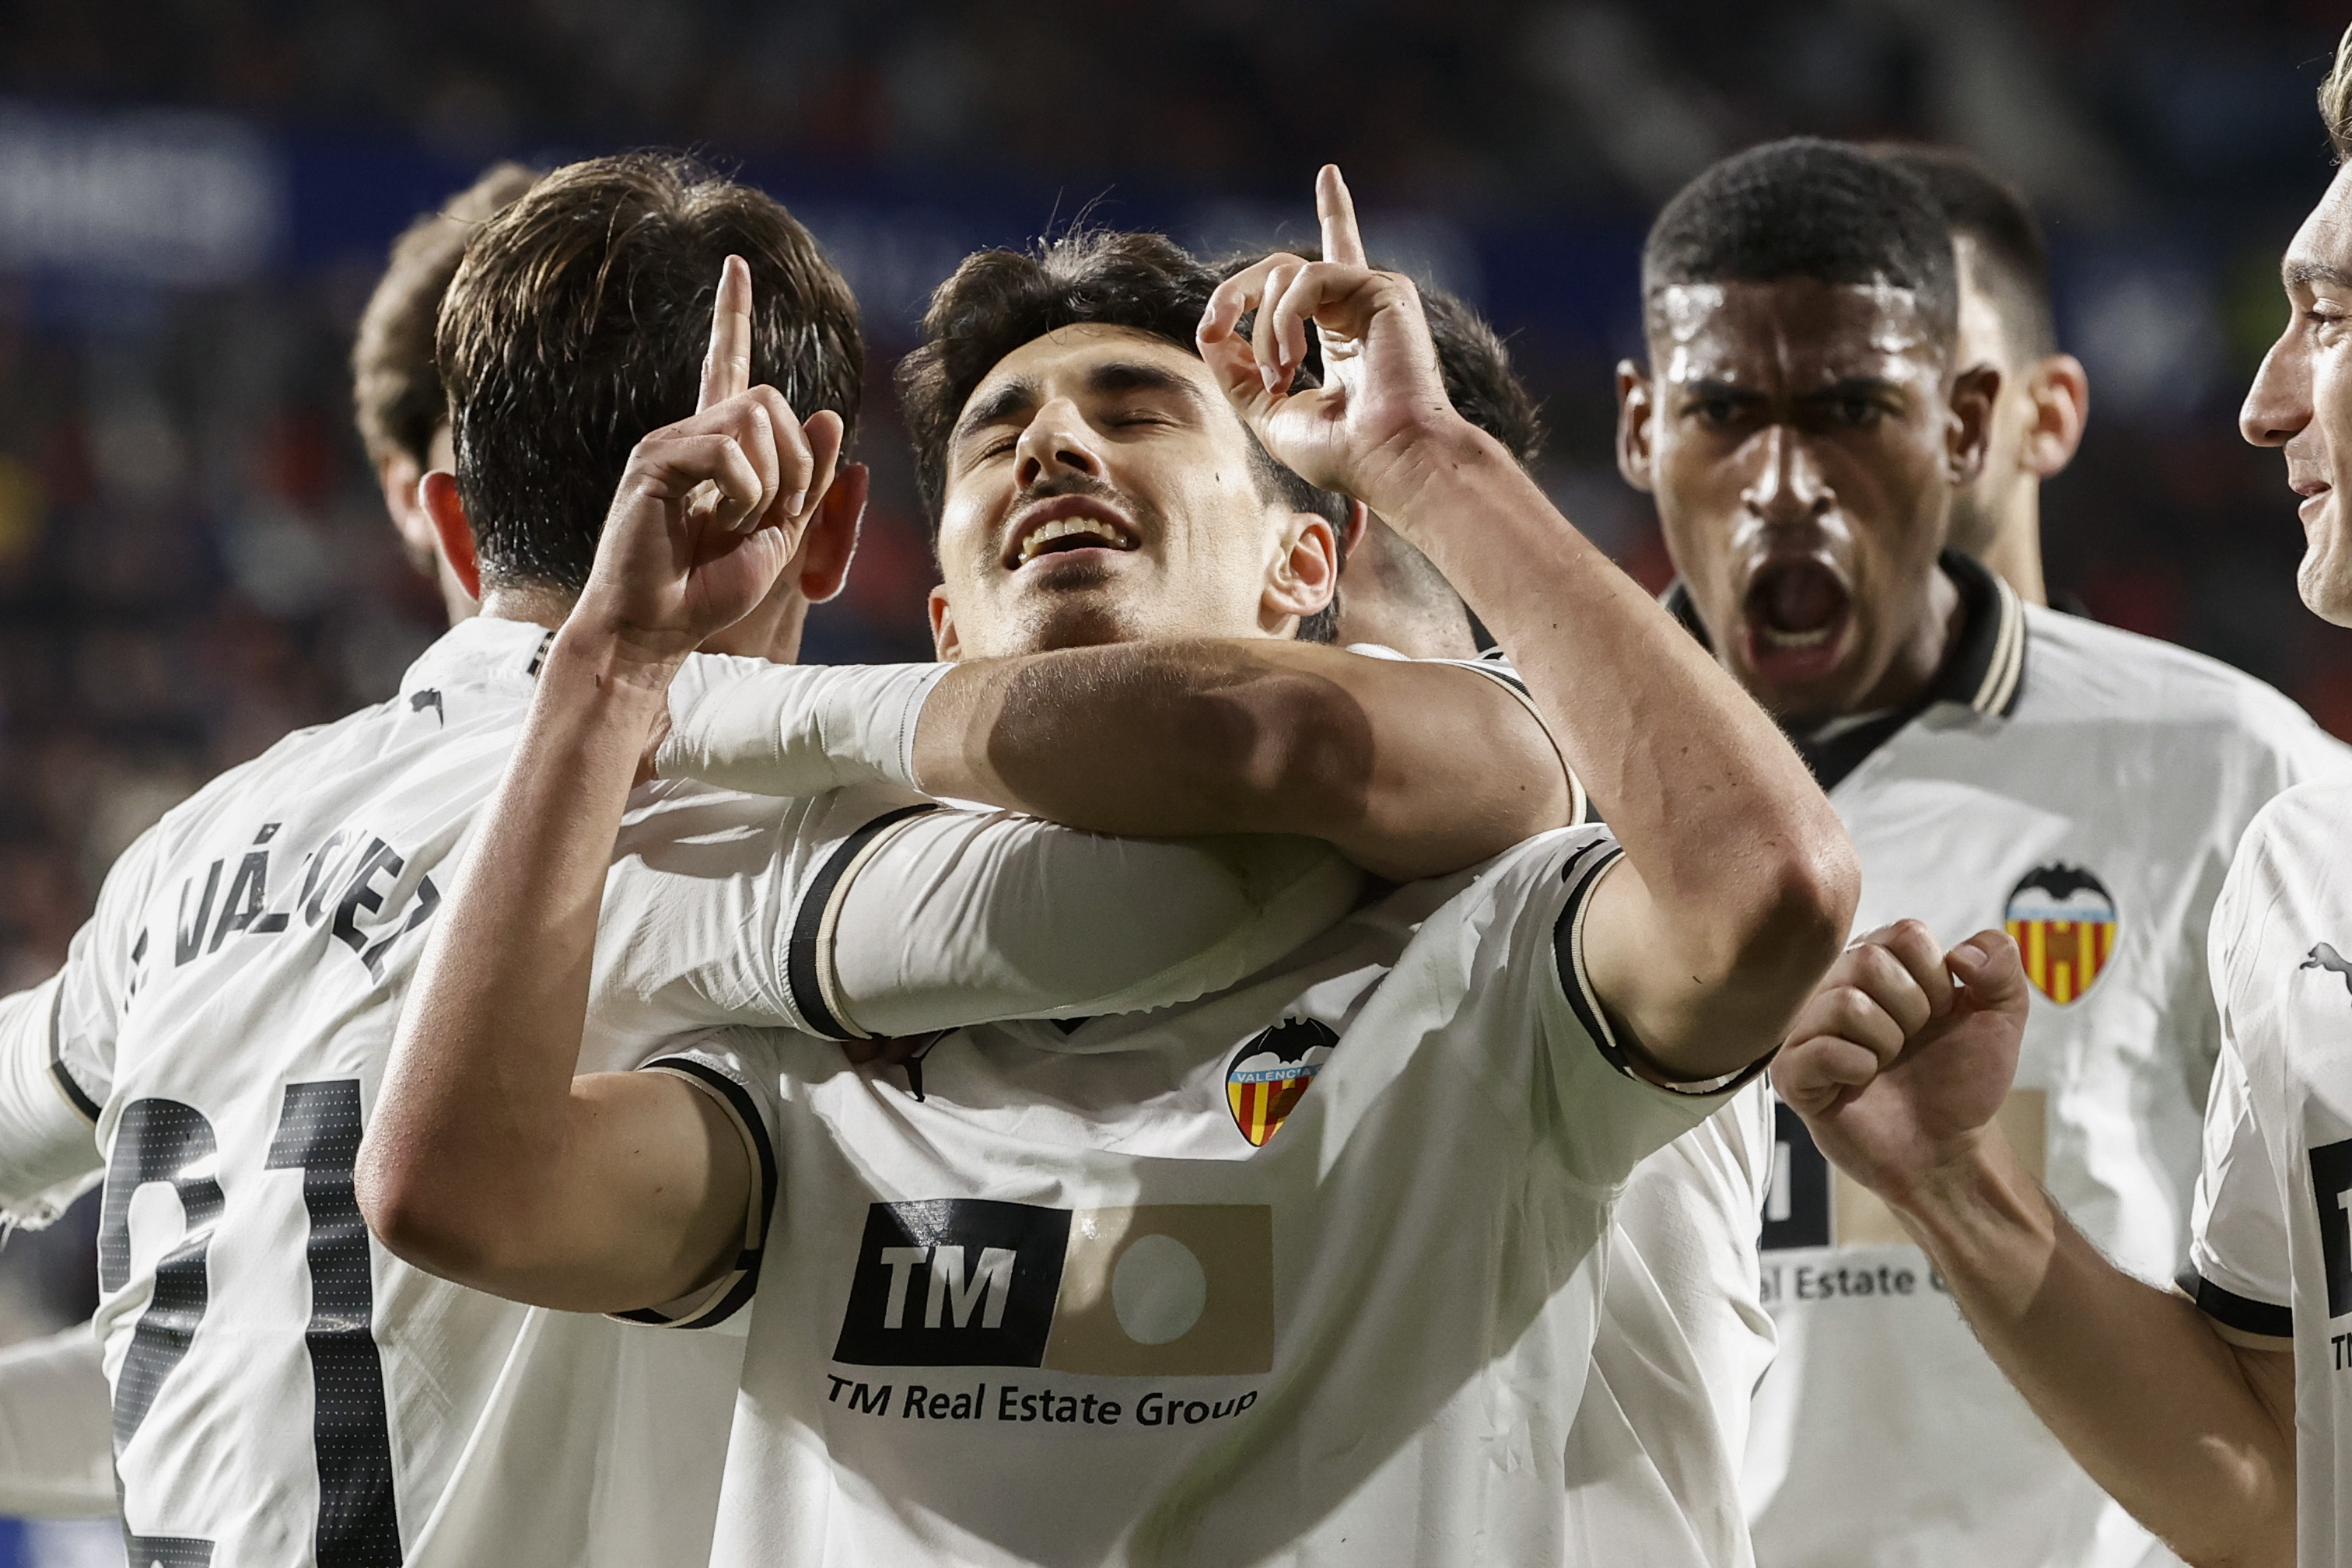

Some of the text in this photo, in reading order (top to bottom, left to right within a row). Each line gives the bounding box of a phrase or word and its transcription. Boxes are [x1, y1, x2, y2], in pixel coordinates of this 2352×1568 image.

[880, 1246, 1017, 1329] TM
[1795, 1265, 1915, 1300] Estate
[826, 1374, 1258, 1426] TM Real Estate Group
